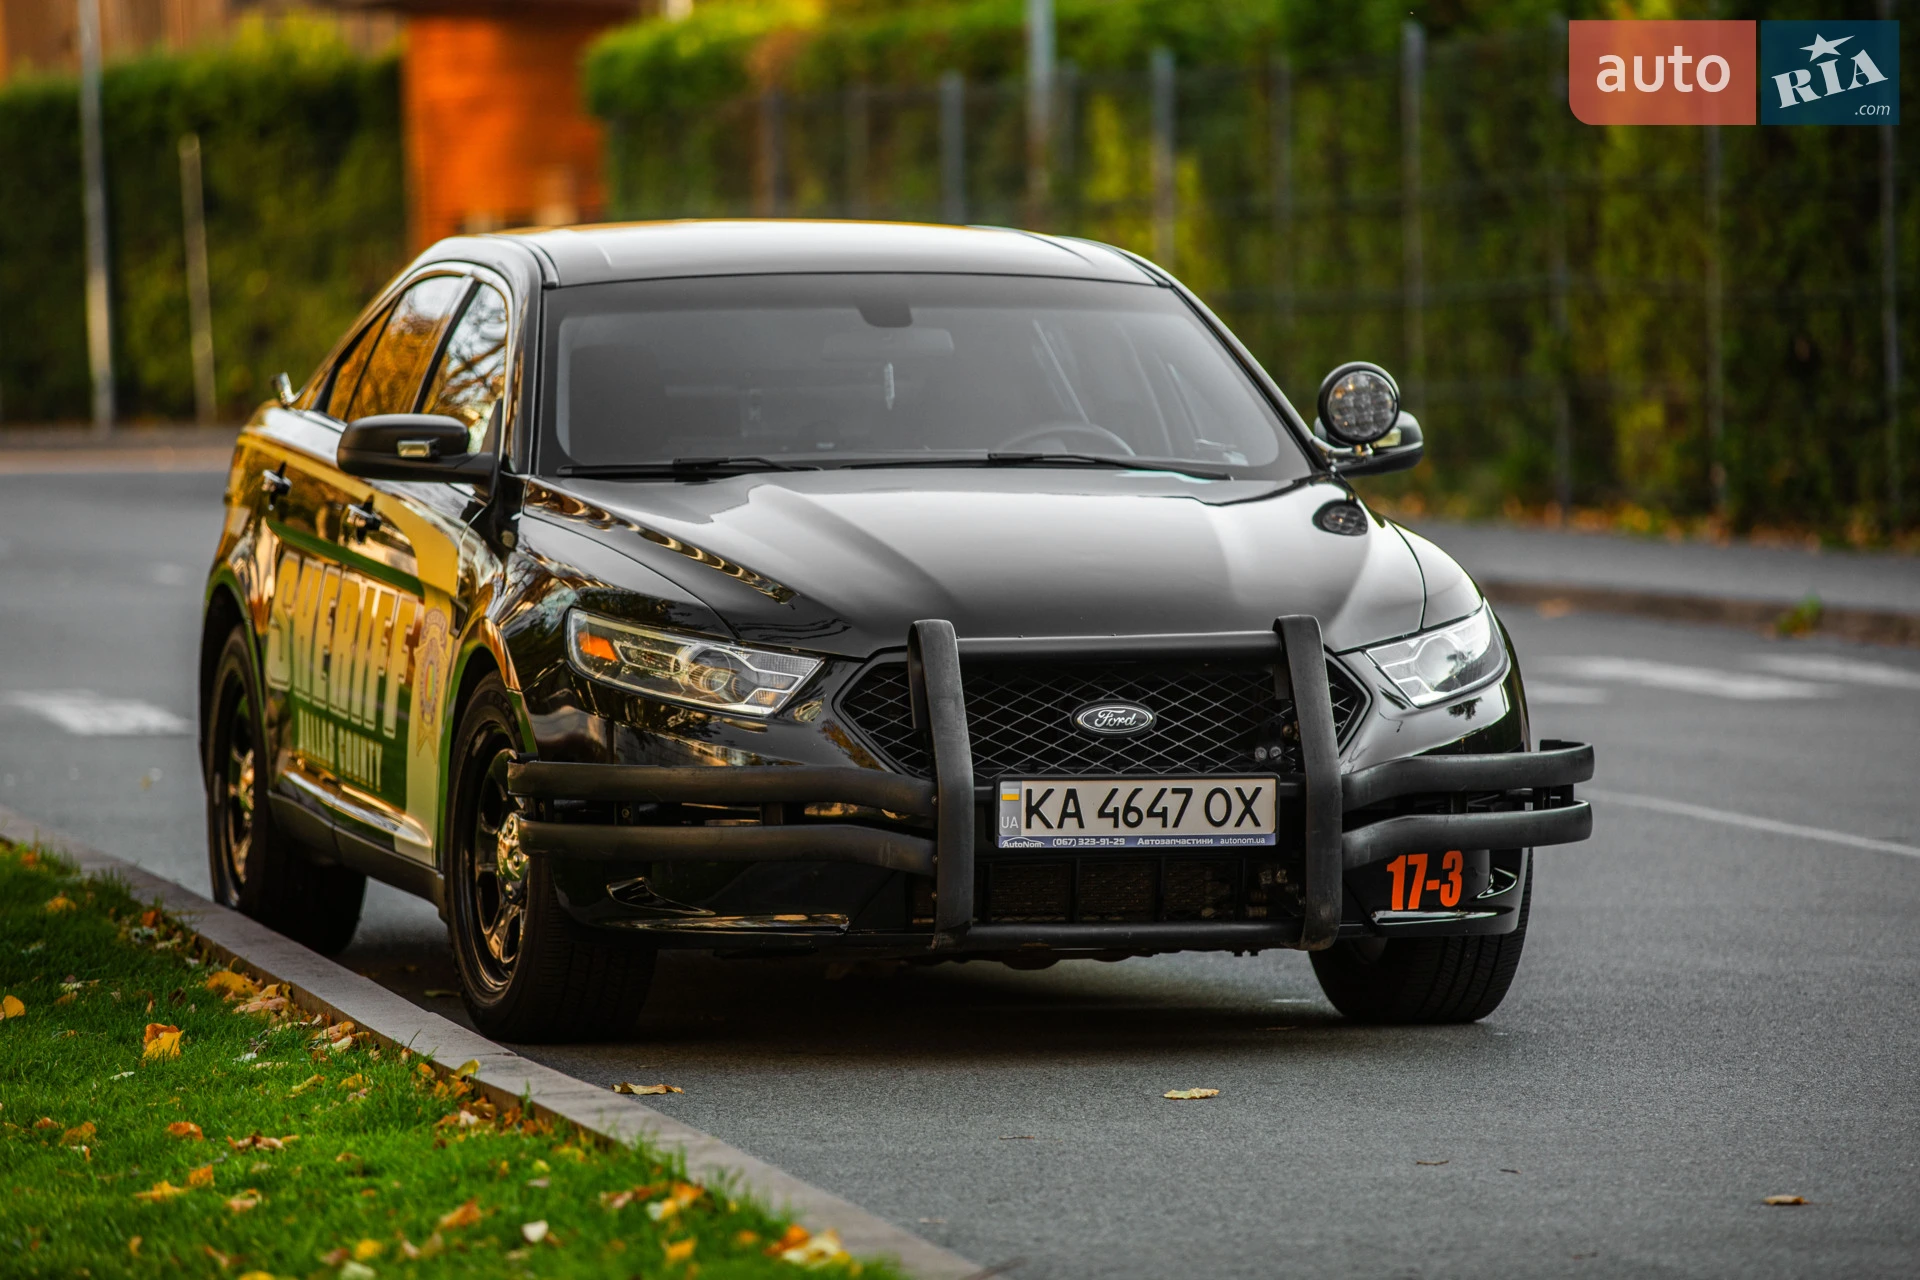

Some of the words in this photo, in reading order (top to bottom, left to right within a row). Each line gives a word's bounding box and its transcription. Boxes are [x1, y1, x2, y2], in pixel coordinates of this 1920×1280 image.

[266, 550, 422, 738] SHERIFF
[1094, 709, 1137, 727] Ford
[1025, 788, 1085, 829] KA
[1097, 787, 1194, 829] 4647
[1204, 786, 1263, 828] OX
[1001, 816, 1019, 829] UA
[1002, 840, 1043, 848] AutoNom
[1052, 838, 1077, 847] (067)
[1078, 837, 1126, 846] 323-91-29
[1137, 838, 1214, 846] Автозапчастини
[1219, 837, 1266, 845] autonom.ua
[1386, 850, 1464, 911] 17-3
